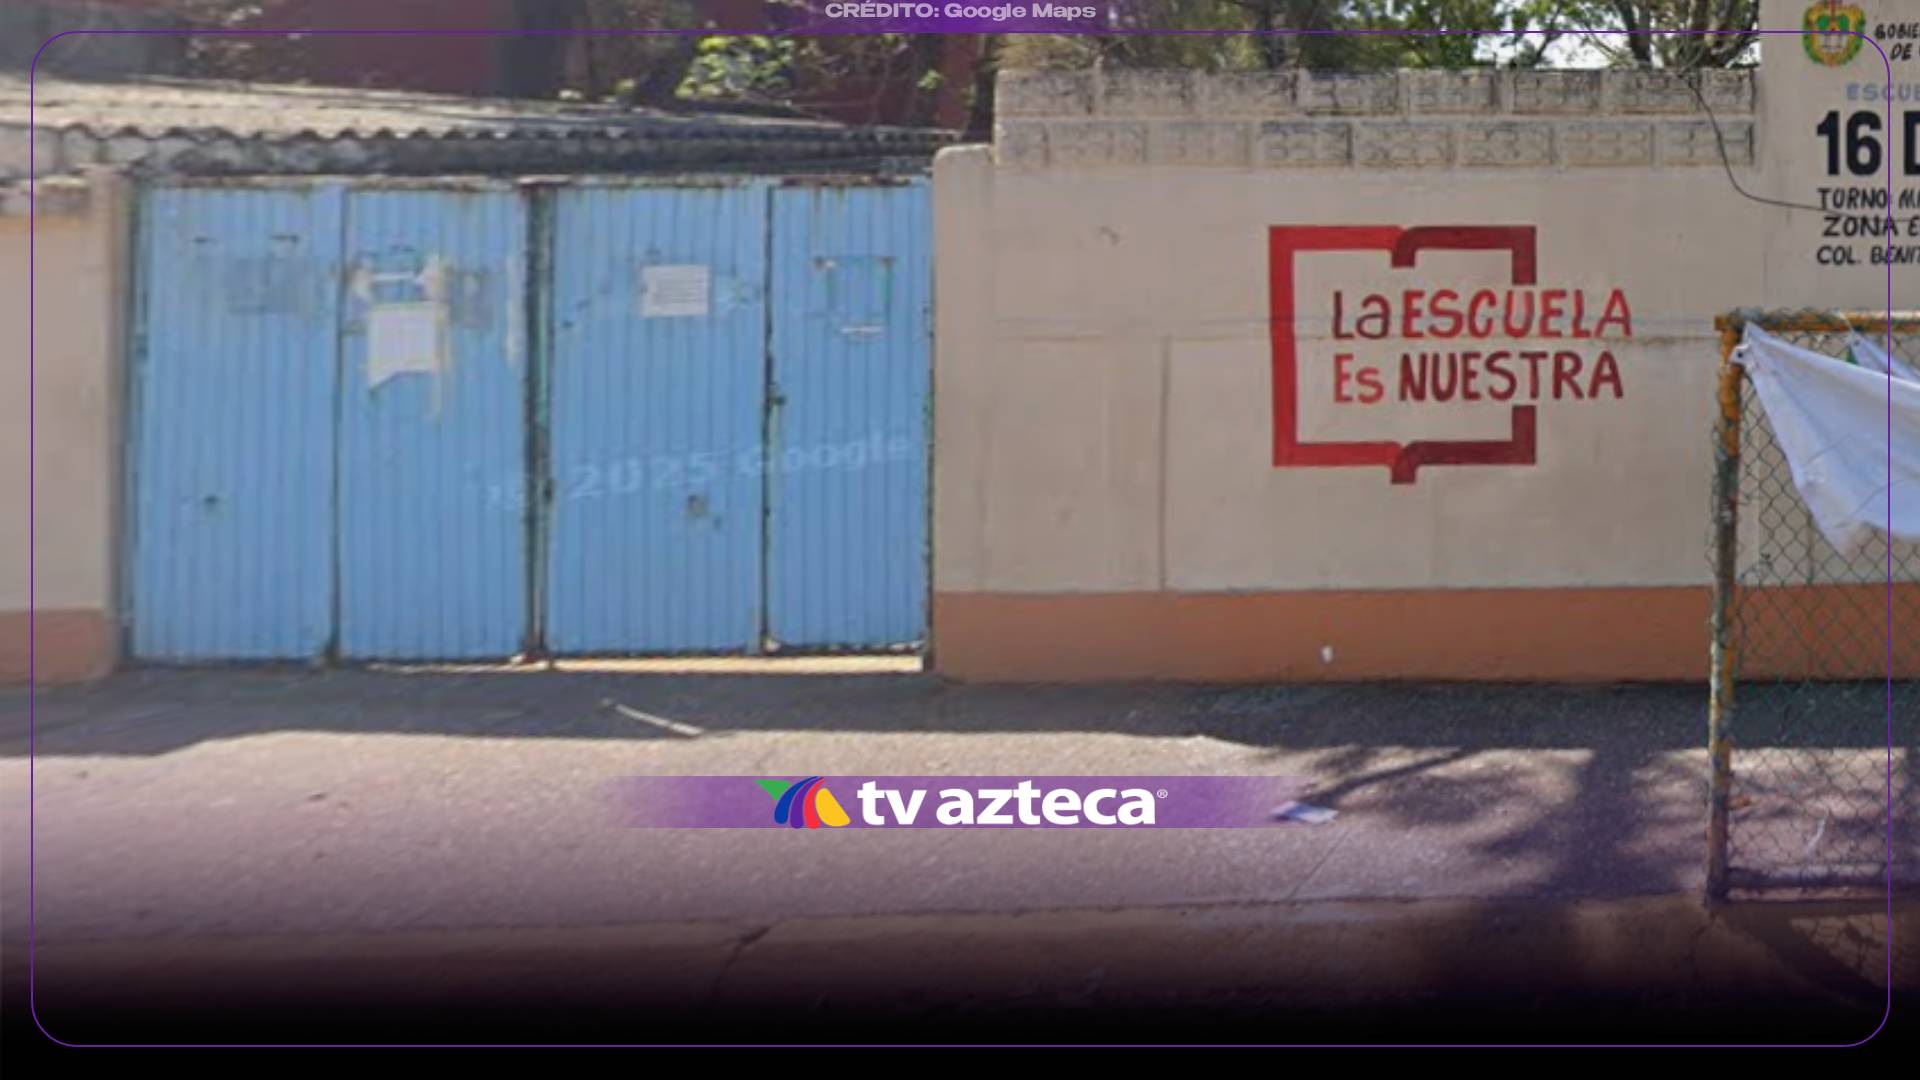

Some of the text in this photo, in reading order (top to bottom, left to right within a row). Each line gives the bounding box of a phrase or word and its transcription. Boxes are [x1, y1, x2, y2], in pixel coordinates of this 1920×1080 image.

[1890, 43, 1912, 61] DE
[1817, 110, 1882, 175] 16
[1822, 215, 1898, 236] ZONA
[1332, 288, 1633, 340] La ESCUELA
[1333, 350, 1624, 404] Es NUESTRA
